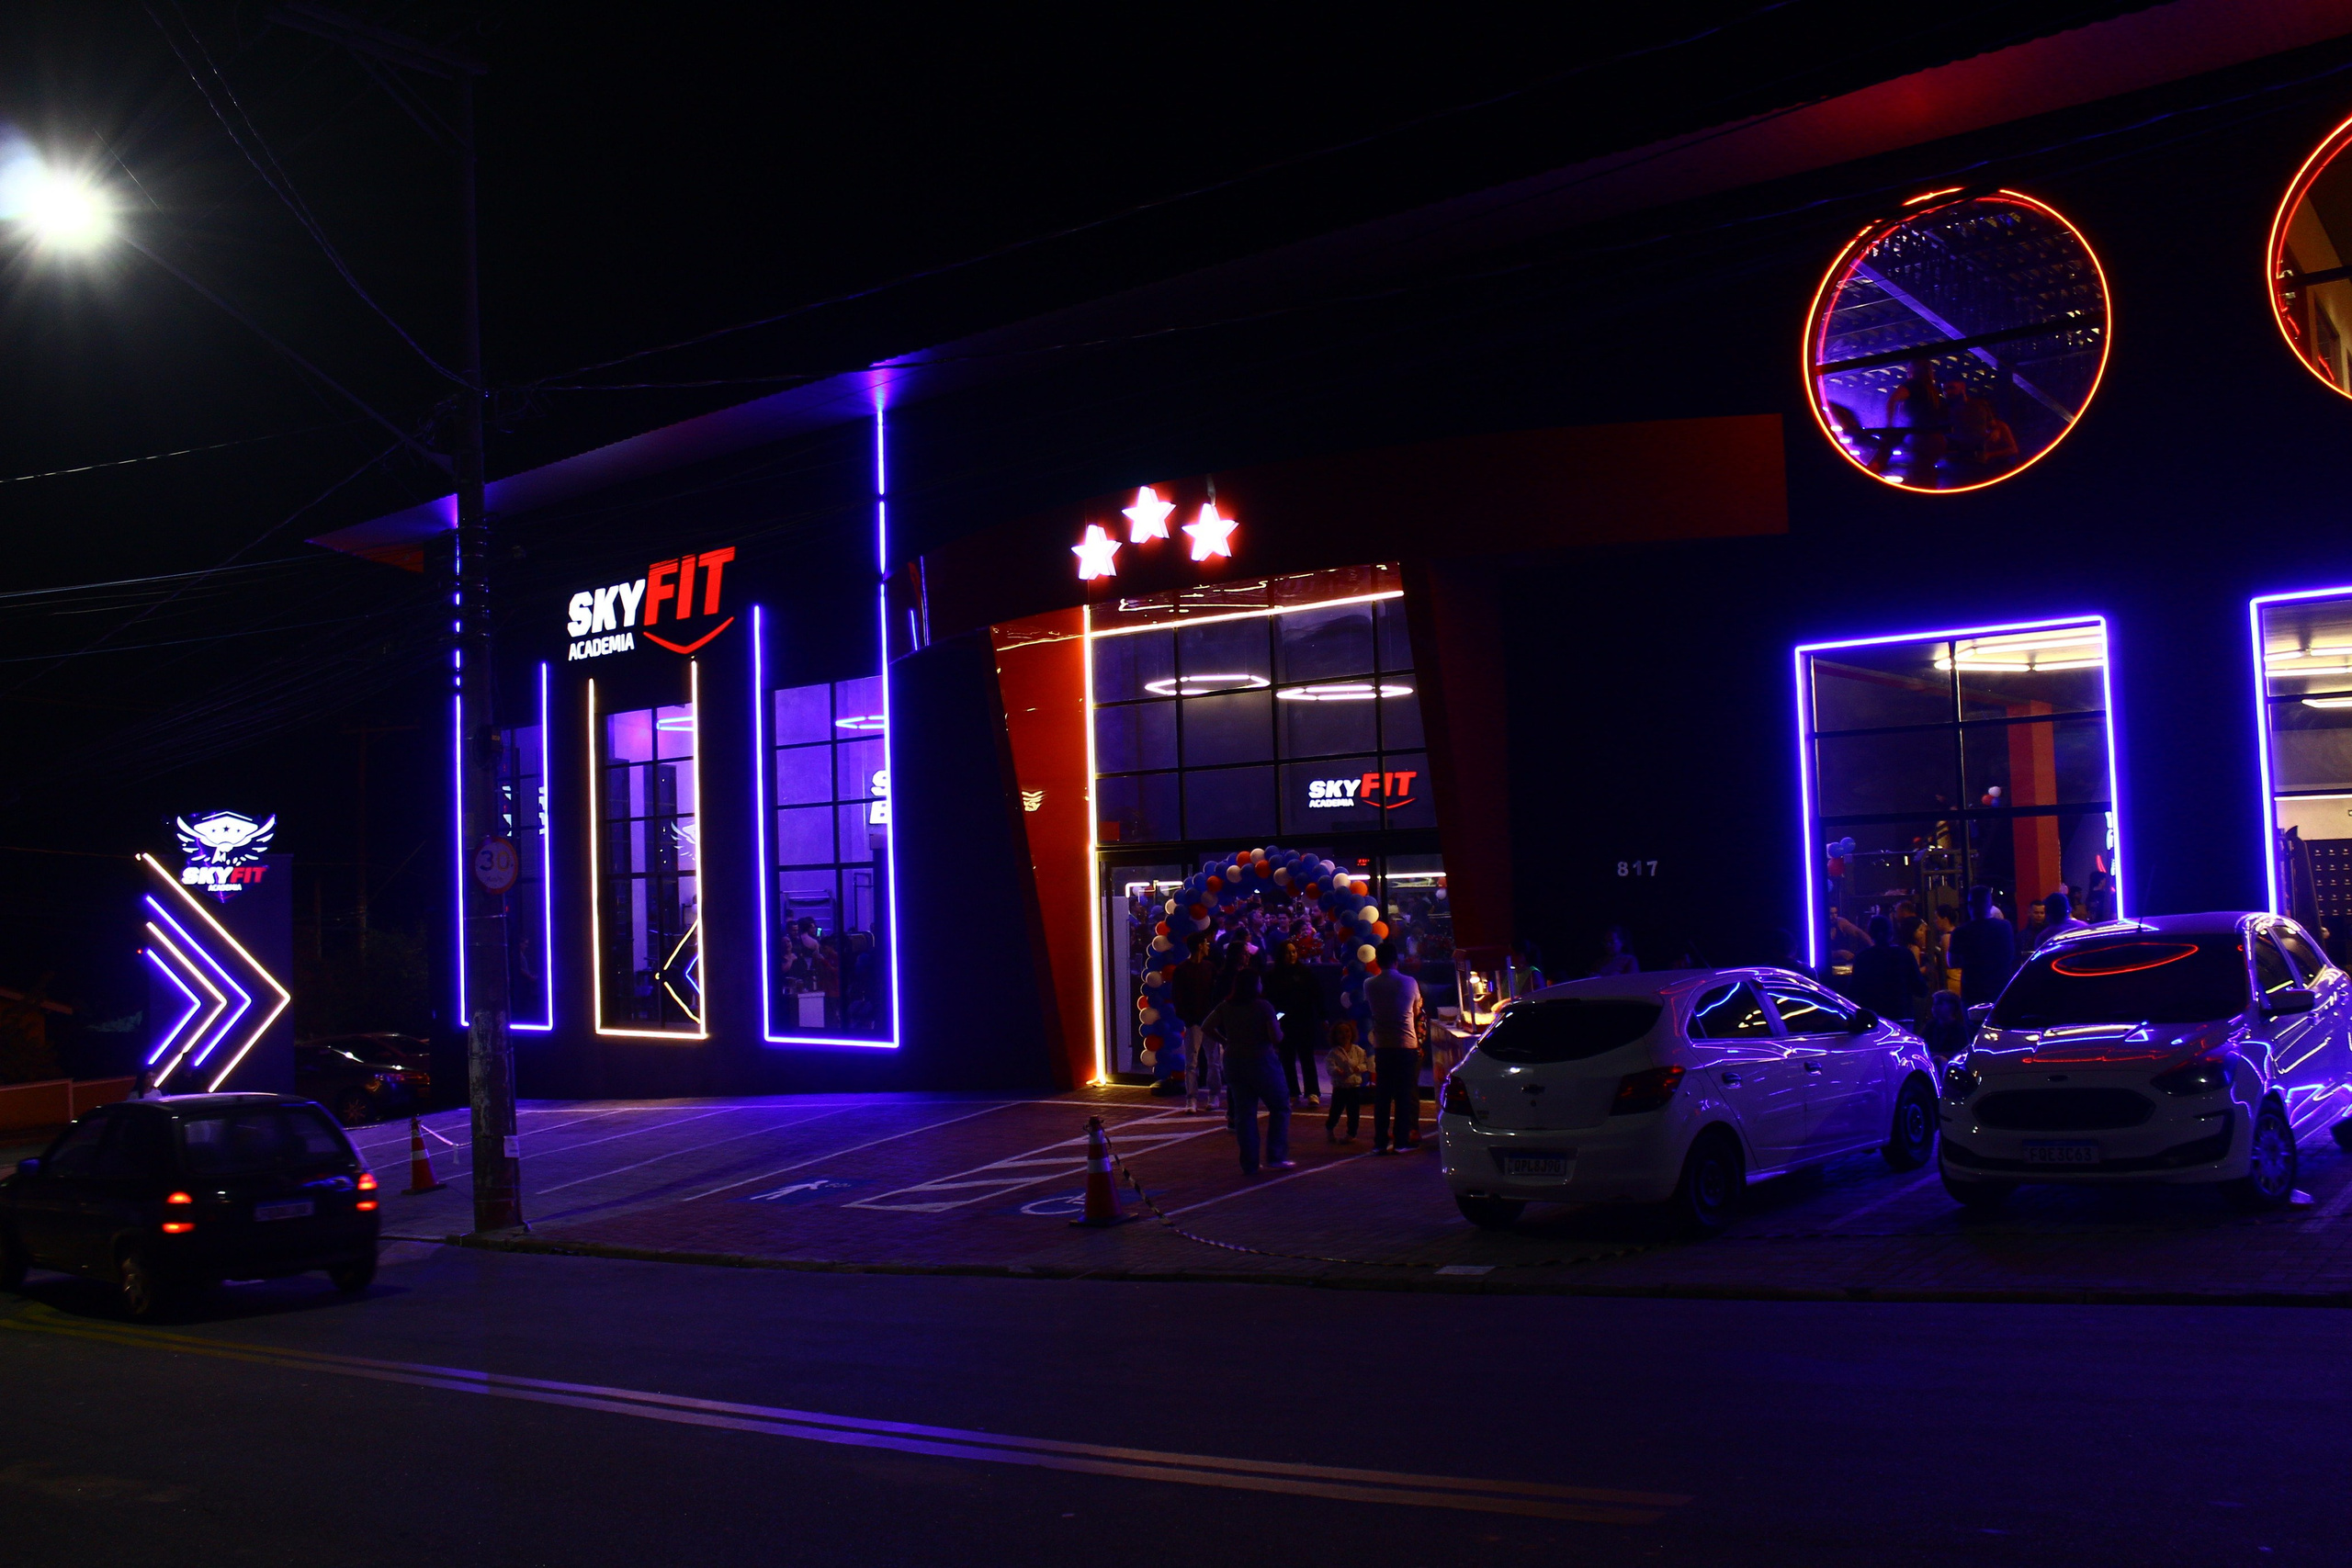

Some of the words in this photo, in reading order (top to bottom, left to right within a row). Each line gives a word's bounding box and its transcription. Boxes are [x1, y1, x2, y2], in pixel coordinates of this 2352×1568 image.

[568, 632, 635, 661] ACADEMIA
[1308, 797, 1355, 808] ACADEMIA
[480, 850, 511, 872] 30
[1617, 860, 1658, 877] 817
